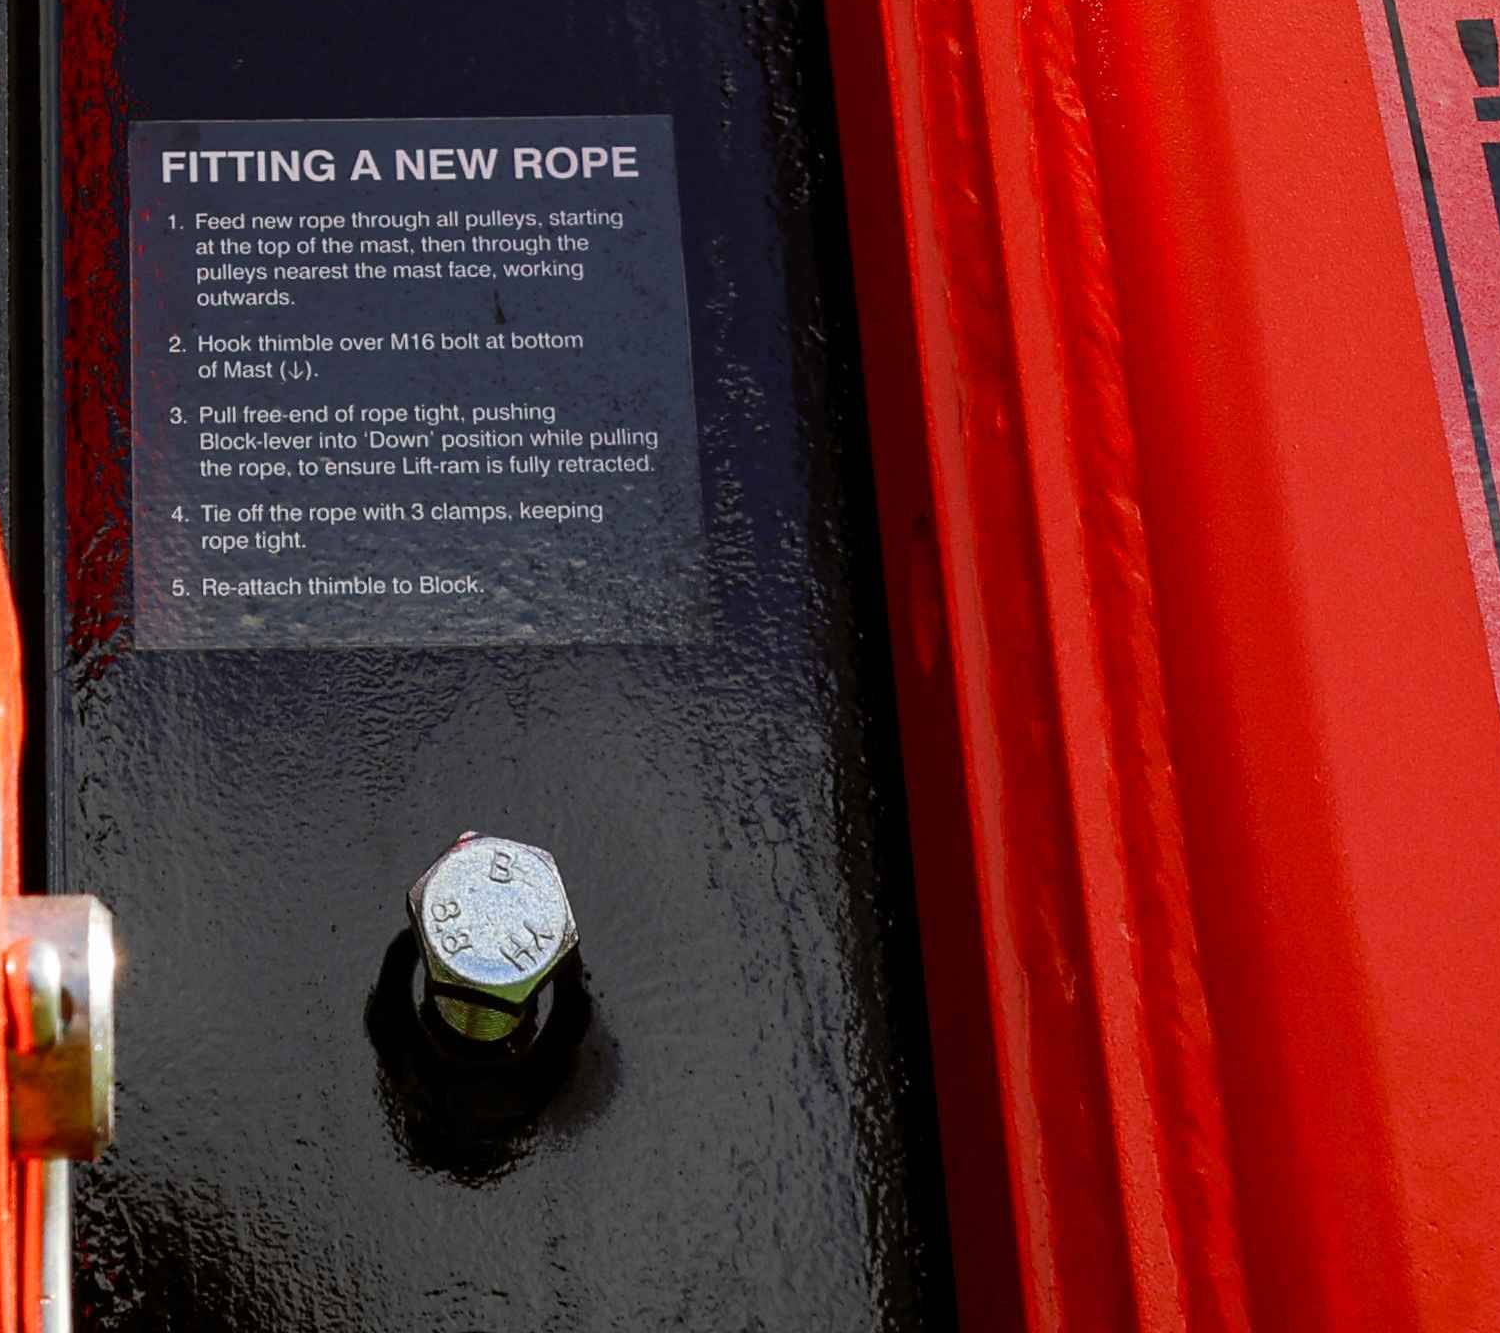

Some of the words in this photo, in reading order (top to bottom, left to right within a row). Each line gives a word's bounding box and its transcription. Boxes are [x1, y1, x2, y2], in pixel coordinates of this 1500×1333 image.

[162, 148, 336, 183] FITTING
[349, 149, 382, 182] A
[395, 148, 498, 181] NEW
[513, 146, 640, 180] ROPE
[168, 213, 184, 230] 1.
[195, 212, 246, 231] Feed
[251, 215, 294, 230] new
[299, 214, 346, 232] rope
[351, 209, 430, 233] through
[436, 209, 459, 228] all
[548, 210, 624, 230] starting
[219, 238, 252, 256] the
[257, 238, 291, 258] top
[321, 237, 354, 255] the
[420, 236, 466, 254] then
[471, 235, 552, 256] through
[557, 234, 590, 252] the
[196, 263, 268, 286] pulleys
[273, 262, 349, 281] nearest
[354, 261, 387, 279] the
[392, 262, 443, 279] mast
[502, 260, 584, 282] working
[196, 288, 296, 307] outwards.
[197, 334, 252, 353] Hook
[257, 333, 334, 353] thimble
[339, 336, 384, 352] over
[390, 332, 436, 351] M16
[440, 332, 480, 350] bolt
[510, 332, 584, 350] bottom
[223, 360, 273, 379] Mast
[199, 405, 237, 425] Pull
[243, 404, 329, 424] free-end
[360, 407, 408, 427] rope
[472, 402, 556, 426] pushing
[199, 431, 313, 451] Block-lever
[319, 432, 358, 450] into
[441, 430, 524, 453] position
[529, 428, 584, 447] while
[589, 428, 659, 451] pulling
[199, 459, 233, 478] the
[323, 457, 396, 477] ensure
[402, 456, 480, 475] Lift-ram
[509, 455, 551, 478] fully
[557, 454, 655, 473] retracted.
[200, 504, 232, 523] Tie
[237, 503, 264, 523] off
[269, 504, 303, 523] the
[309, 506, 357, 524] rope
[362, 503, 406, 521] with
[519, 500, 604, 522] keeping
[201, 535, 250, 554] rope
[254, 530, 307, 553] tight.
[202, 577, 302, 597] Re-attach
[308, 575, 387, 596] thimble
[419, 574, 485, 594] Block.
